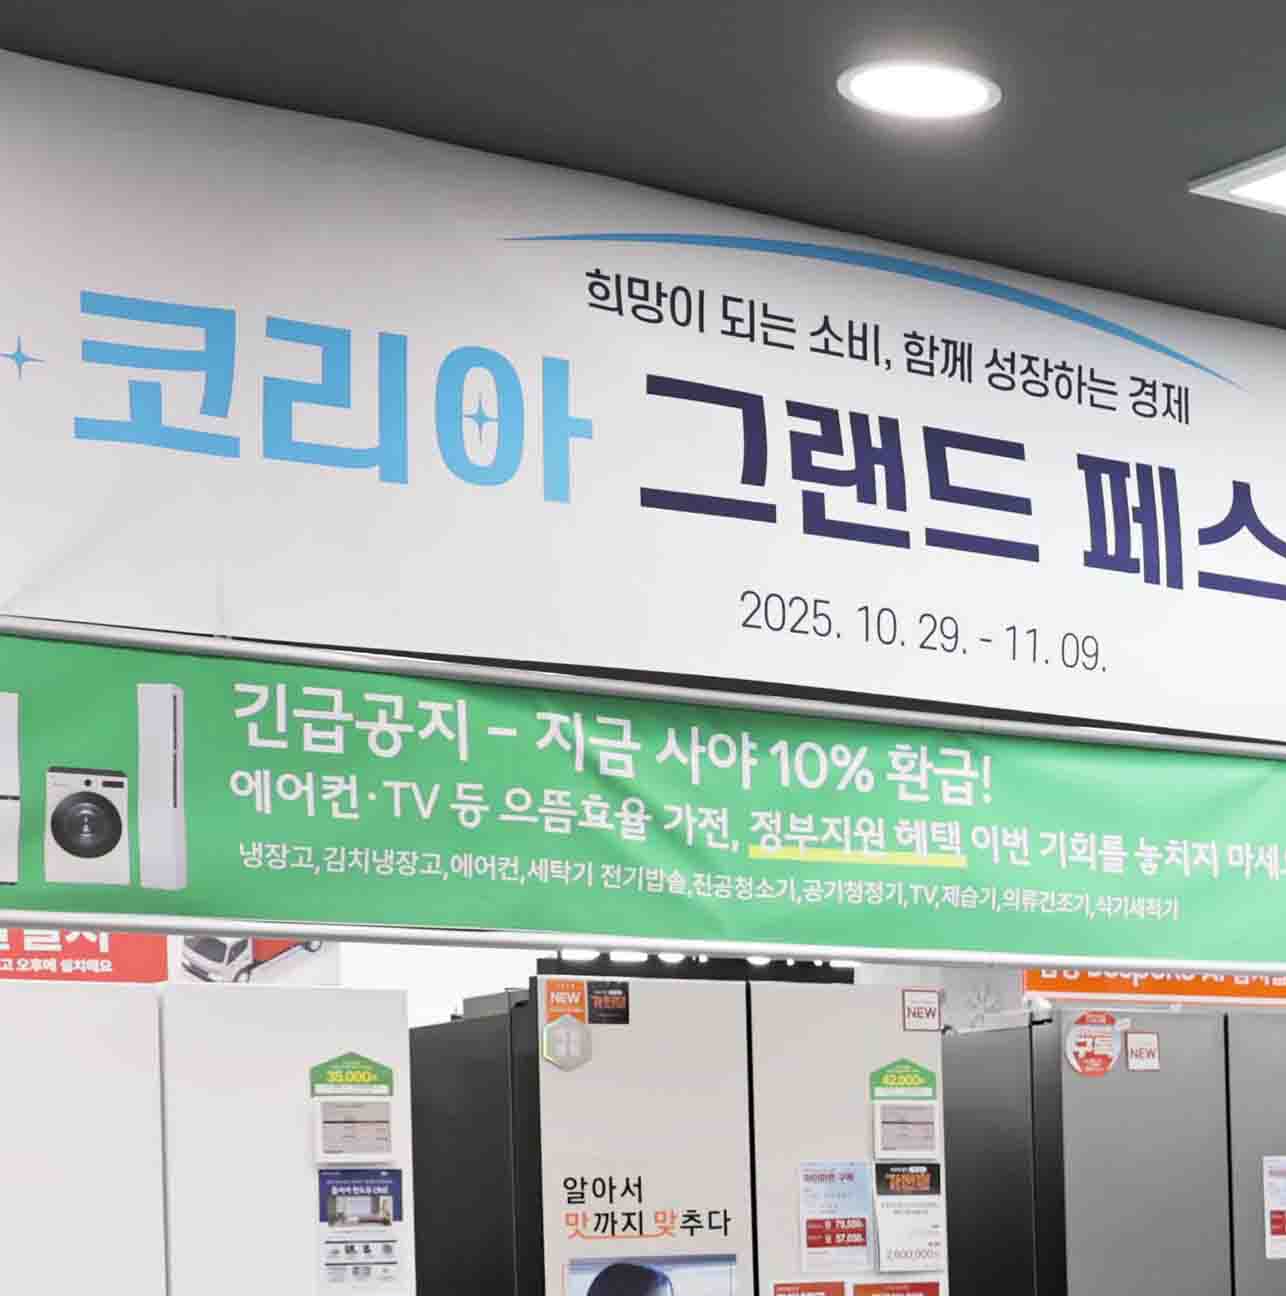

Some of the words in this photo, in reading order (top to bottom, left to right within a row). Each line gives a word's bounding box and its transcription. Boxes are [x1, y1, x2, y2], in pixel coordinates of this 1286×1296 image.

[586, 268, 704, 333] 희망이
[721, 295, 796, 350] 되는
[810, 315, 891, 370] 소비,
[903, 331, 973, 384] 함께
[985, 347, 1120, 412] 성장하는
[1129, 375, 1190, 426] 경제
[74, 290, 593, 503] 코리아
[640, 373, 1039, 562] 그랜드
[740, 591, 841, 639] 2025.
[858, 605, 906, 648] 10.
[918, 614, 968, 654] 29.
[1005, 625, 1050, 666] 11.
[1060, 632, 1108, 672] 09.
[232, 681, 470, 761] 긴급공지
[535, 709, 642, 780] 지금
[656, 725, 758, 790] 사야
[769, 740, 875, 793] 10%
[887, 743, 992, 806] 환급!
[450, 782, 491, 829] 등
[500, 787, 654, 842] 으뜸효율
[662, 805, 741, 853] 가전,
[750, 809, 887, 856] 정부지원
[894, 818, 963, 858] 혜택
[971, 824, 1031, 865] 이번
[1040, 831, 1128, 873] 기회를
[1134, 839, 1220, 878] 놓치지
[550, 991, 581, 1006] NEW
[908, 1008, 936, 1019] NEW
[1130, 1047, 1156, 1059] NEW
[562, 1175, 643, 1204] 알아서
[564, 1209, 645, 1237] 맛까지
